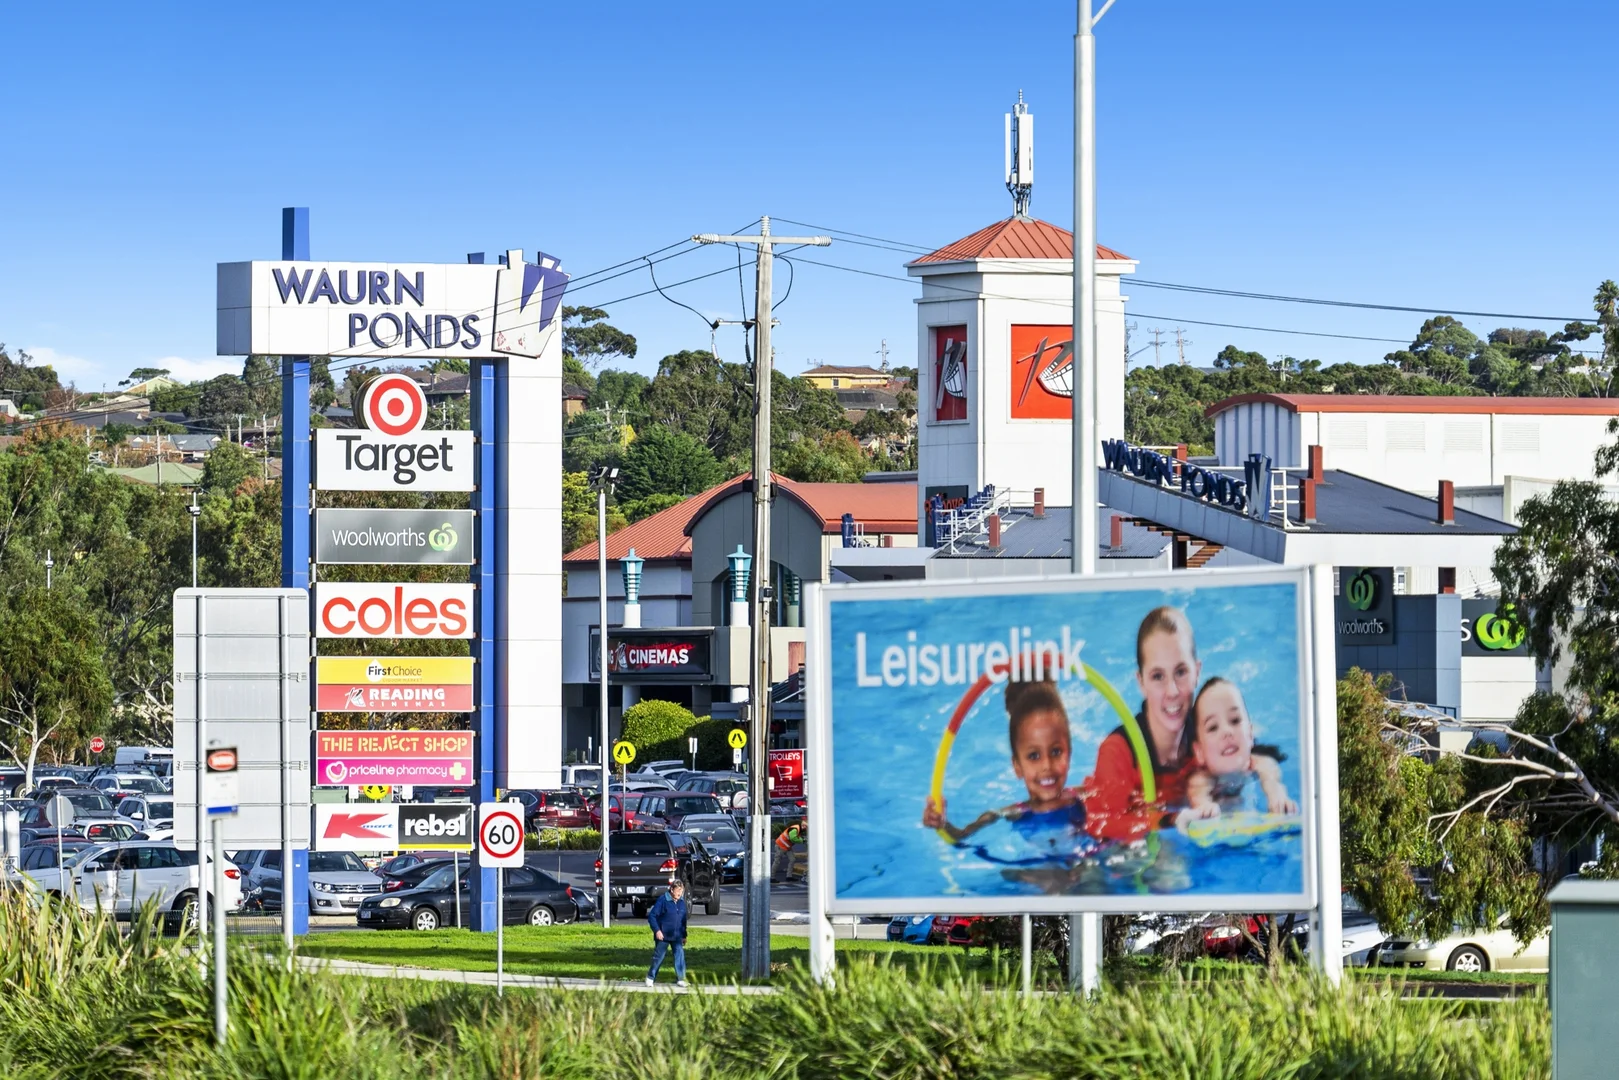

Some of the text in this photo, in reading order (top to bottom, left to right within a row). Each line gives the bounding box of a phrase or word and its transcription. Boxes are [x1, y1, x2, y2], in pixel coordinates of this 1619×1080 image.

[272, 267, 425, 307] WAURN
[348, 312, 481, 350] PONDS
[336, 434, 454, 485] Target
[1101, 438, 1247, 511] WAURN PONDS
[332, 526, 426, 547] Woolworths
[322, 586, 468, 636] coles
[629, 649, 689, 664] CINEMAS
[855, 625, 1088, 688] Leisurelink
[368, 665, 422, 676] First Choice
[369, 688, 445, 701] READING
[322, 735, 468, 752] THE REJECT SHOP
[769, 752, 801, 761] TROLLEYS
[349, 764, 448, 777] priceline pharmacy
[404, 813, 466, 837] rebel
[488, 824, 515, 845] 60
